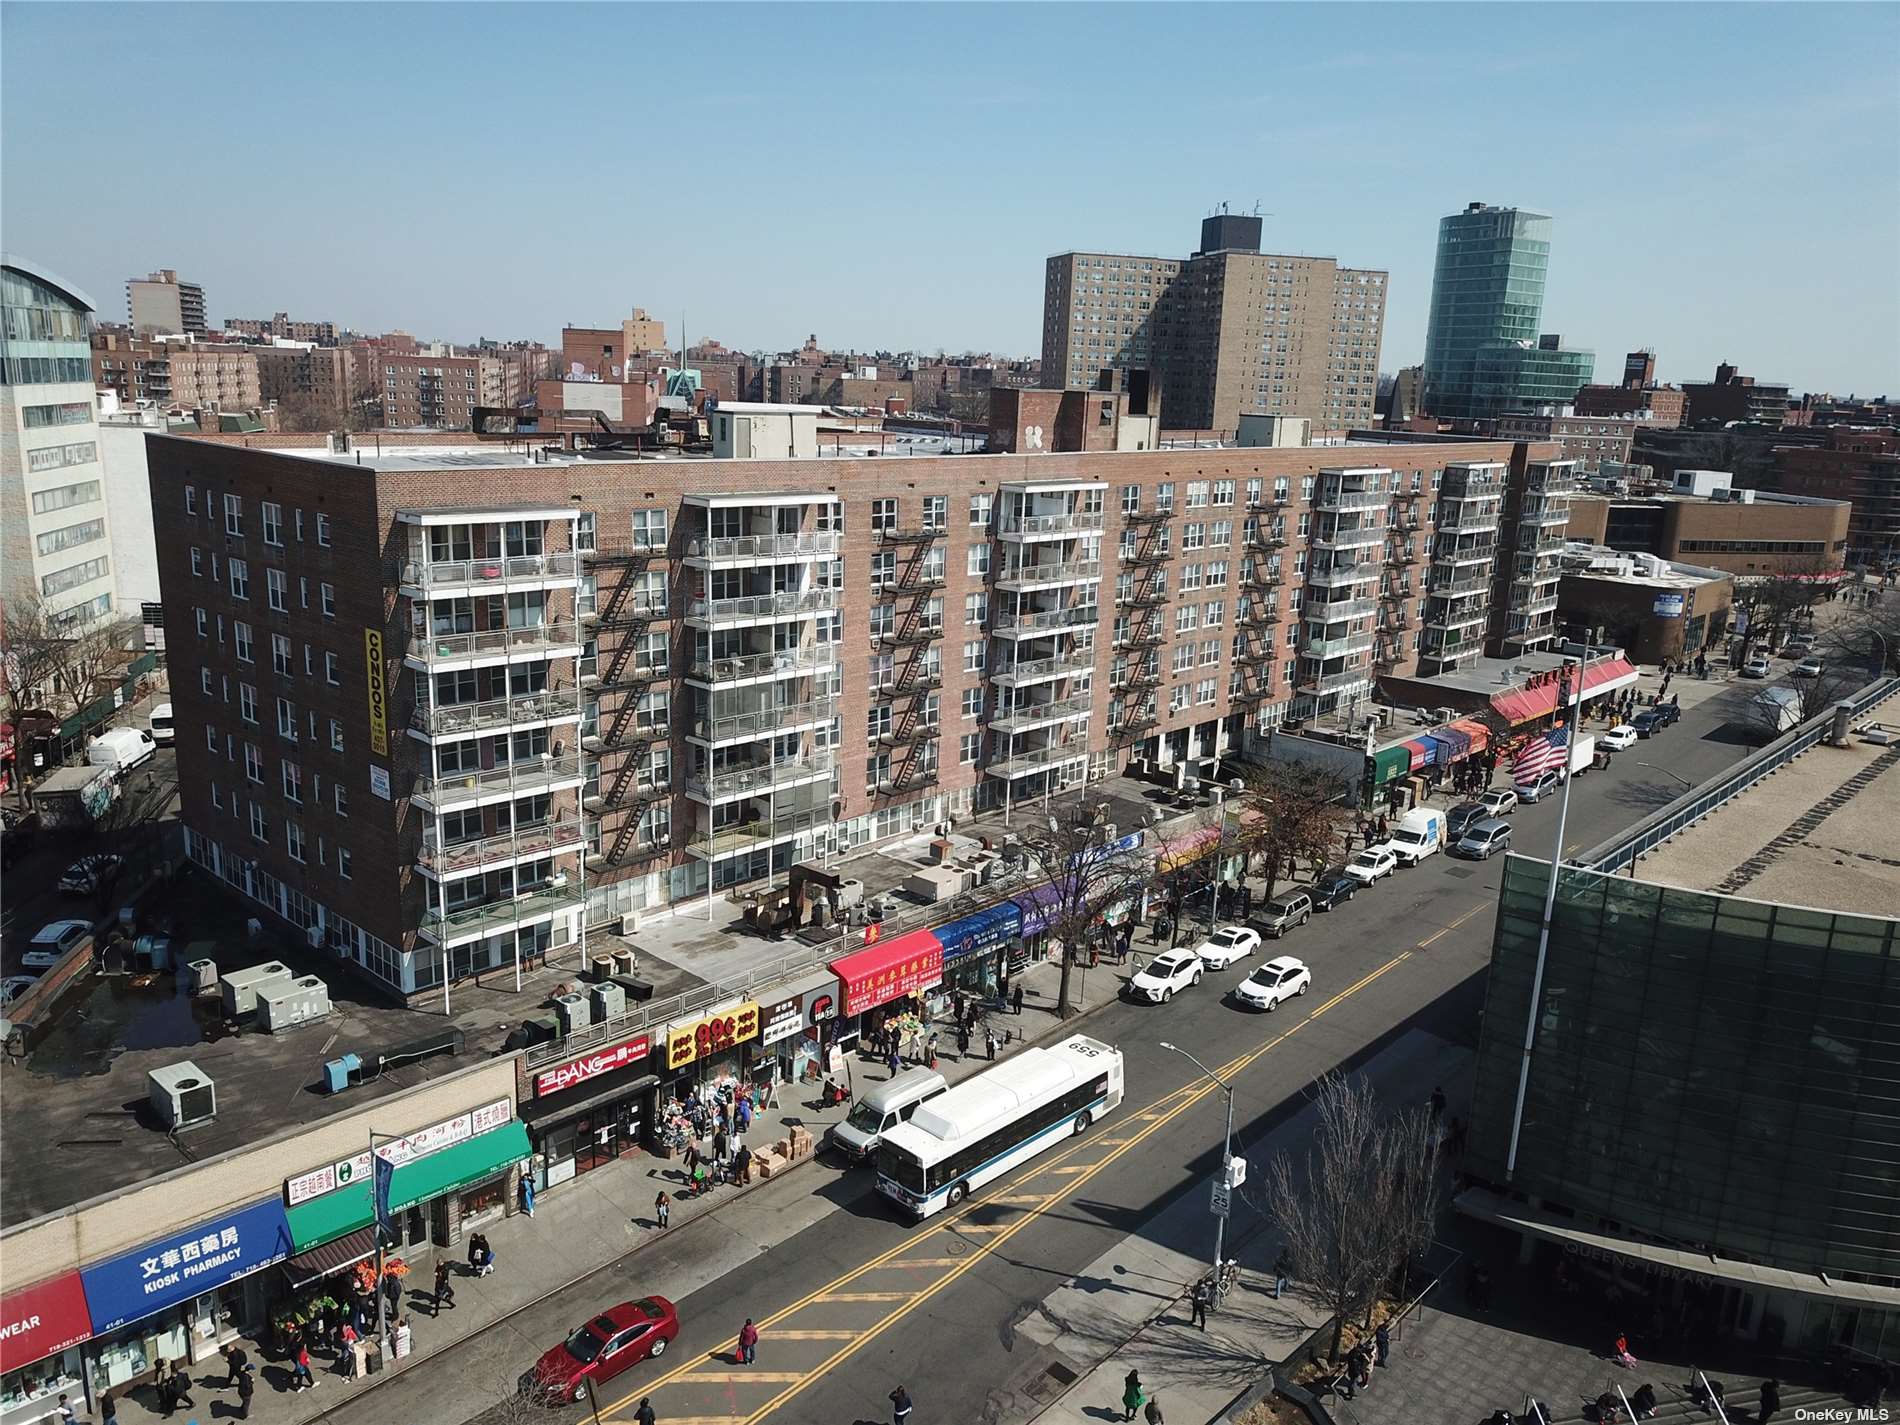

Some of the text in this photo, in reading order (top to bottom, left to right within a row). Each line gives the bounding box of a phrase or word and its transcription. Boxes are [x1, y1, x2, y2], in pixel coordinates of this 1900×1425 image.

[368, 632, 383, 719] CONDOS
[1067, 1042, 1100, 1058] 559
[140, 1226, 239, 1279] 文華西藥房
[144, 1247, 241, 1295] KIOSK PHARMACY
[1563, 1241, 1716, 1289] QUEENS LIBRARY
